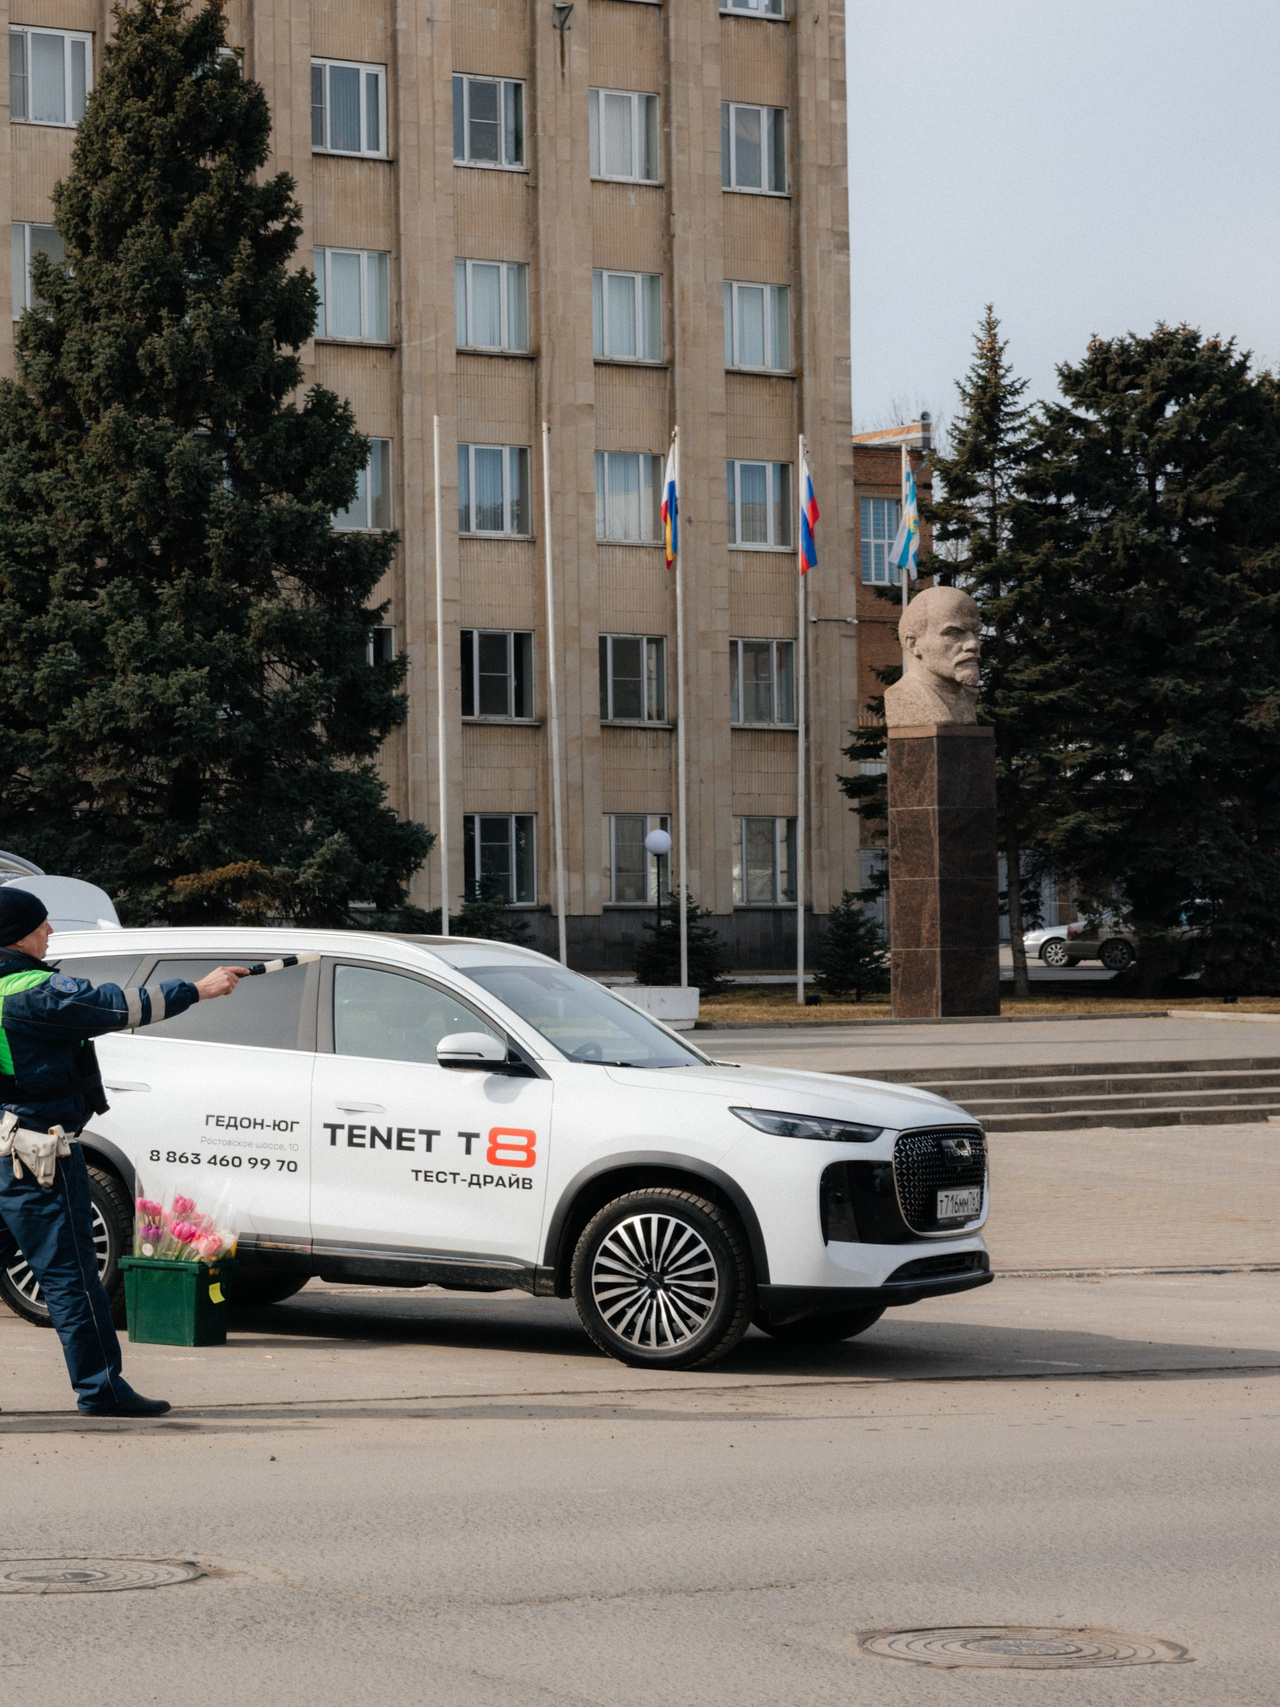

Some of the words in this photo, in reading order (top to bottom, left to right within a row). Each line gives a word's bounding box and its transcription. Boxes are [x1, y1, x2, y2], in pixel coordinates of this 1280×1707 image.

[205, 1114, 300, 1132] ГЕДОН-ЮГ
[200, 1136, 254, 1148] Ростовское
[288, 1143, 299, 1151] 10
[323, 1123, 441, 1152] TENET
[149, 1149, 161, 1162] 8
[166, 1151, 201, 1165] 863
[207, 1154, 242, 1168] 460
[248, 1157, 271, 1170] 99
[276, 1159, 298, 1173] 70
[411, 1169, 533, 1190] ТЕСТ-ДРАЙВ
